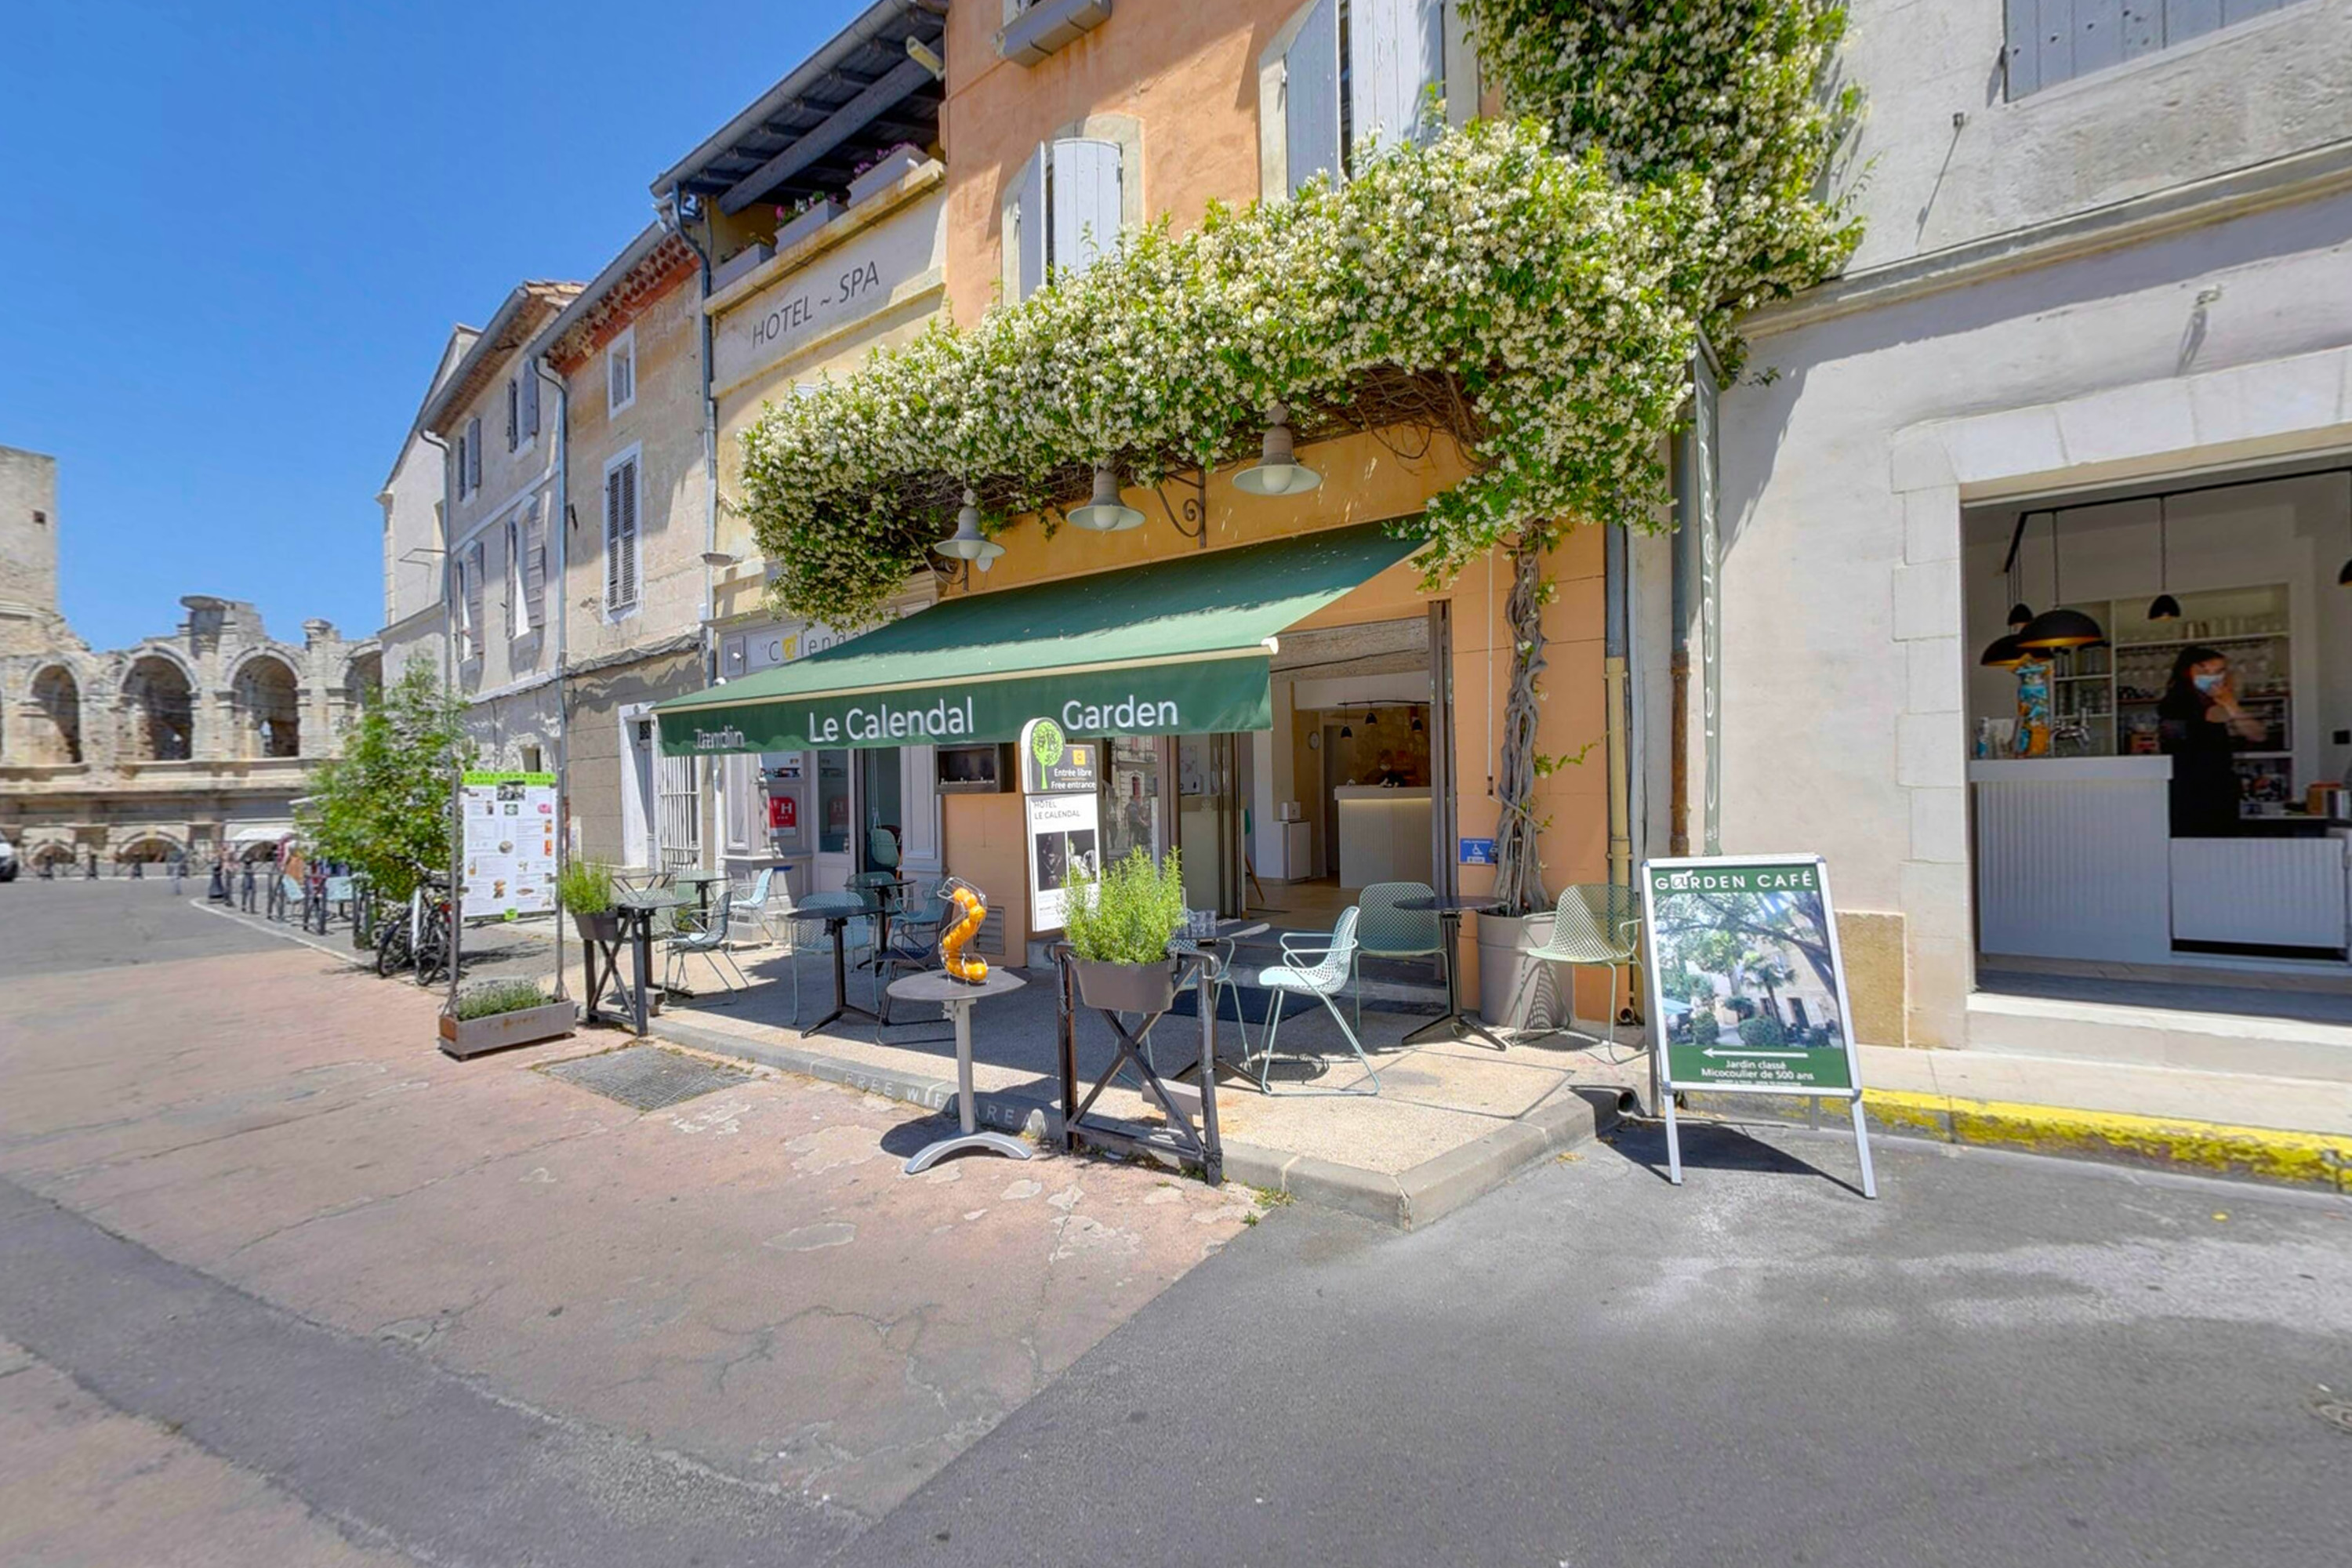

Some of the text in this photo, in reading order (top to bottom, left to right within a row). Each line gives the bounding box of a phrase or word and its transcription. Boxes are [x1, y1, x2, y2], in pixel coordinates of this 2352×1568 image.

[753, 296, 813, 349] HOTEL
[839, 260, 879, 303] SPA
[808, 695, 1179, 743] Le Calendal Garden
[1077, 768, 1093, 777] libre
[1051, 780, 1097, 790] Free entrance
[781, 802, 793, 815] H
[1034, 810, 1081, 820] LE CALENDAL
[1756, 870, 1813, 888] CAFÉ
[1726, 1060, 1757, 1069] Jardin
[1701, 1067, 1815, 1081] Micocoulier de 500 ans
